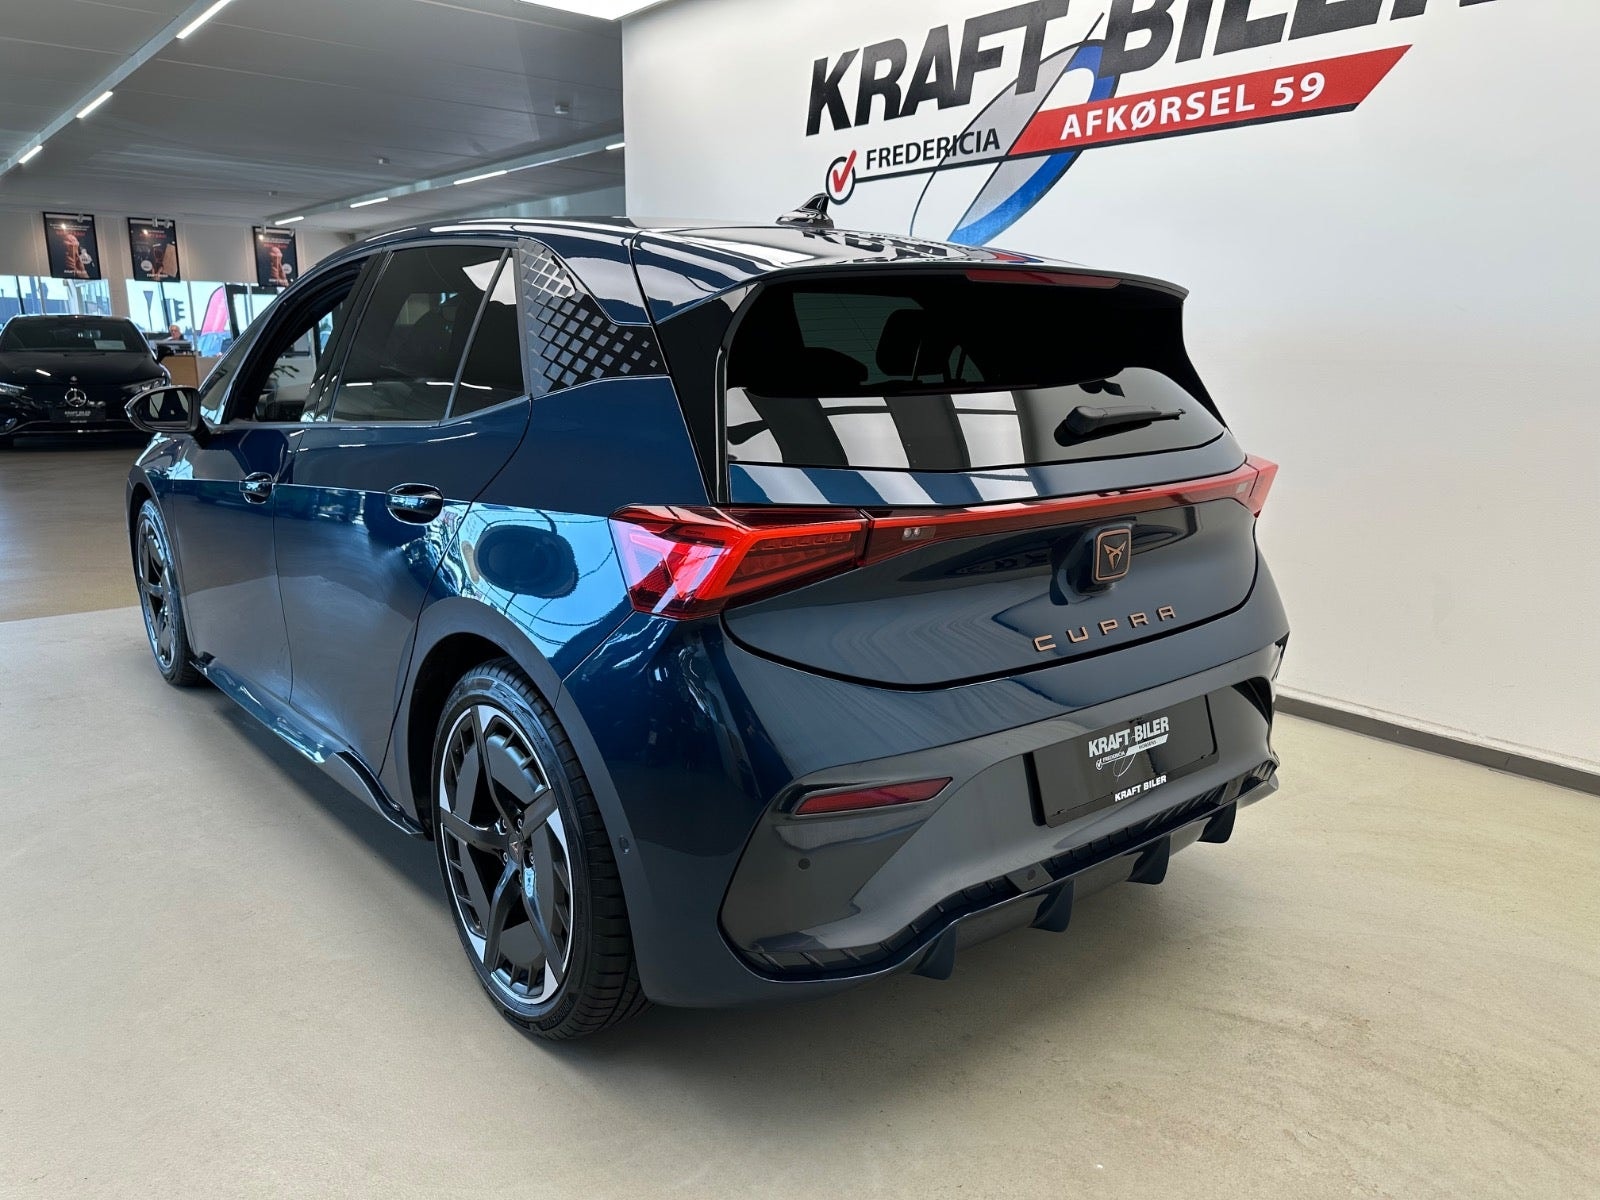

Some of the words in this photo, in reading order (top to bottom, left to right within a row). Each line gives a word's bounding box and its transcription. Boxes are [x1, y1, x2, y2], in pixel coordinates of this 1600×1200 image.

[806, 0, 1070, 136] KRAFT
[1096, 0, 1497, 79] BIL
[1059, 83, 1255, 141] AFKØRSEL
[1271, 72, 1326, 108] 59
[866, 127, 1001, 170] FREDERICIA
[1033, 605, 1177, 652] CUPRA
[1088, 728, 1131, 758] KRAFT
[1134, 716, 1170, 743] BILER
[1114, 784, 1142, 802] KRAFT
[1143, 774, 1167, 791] BILER
